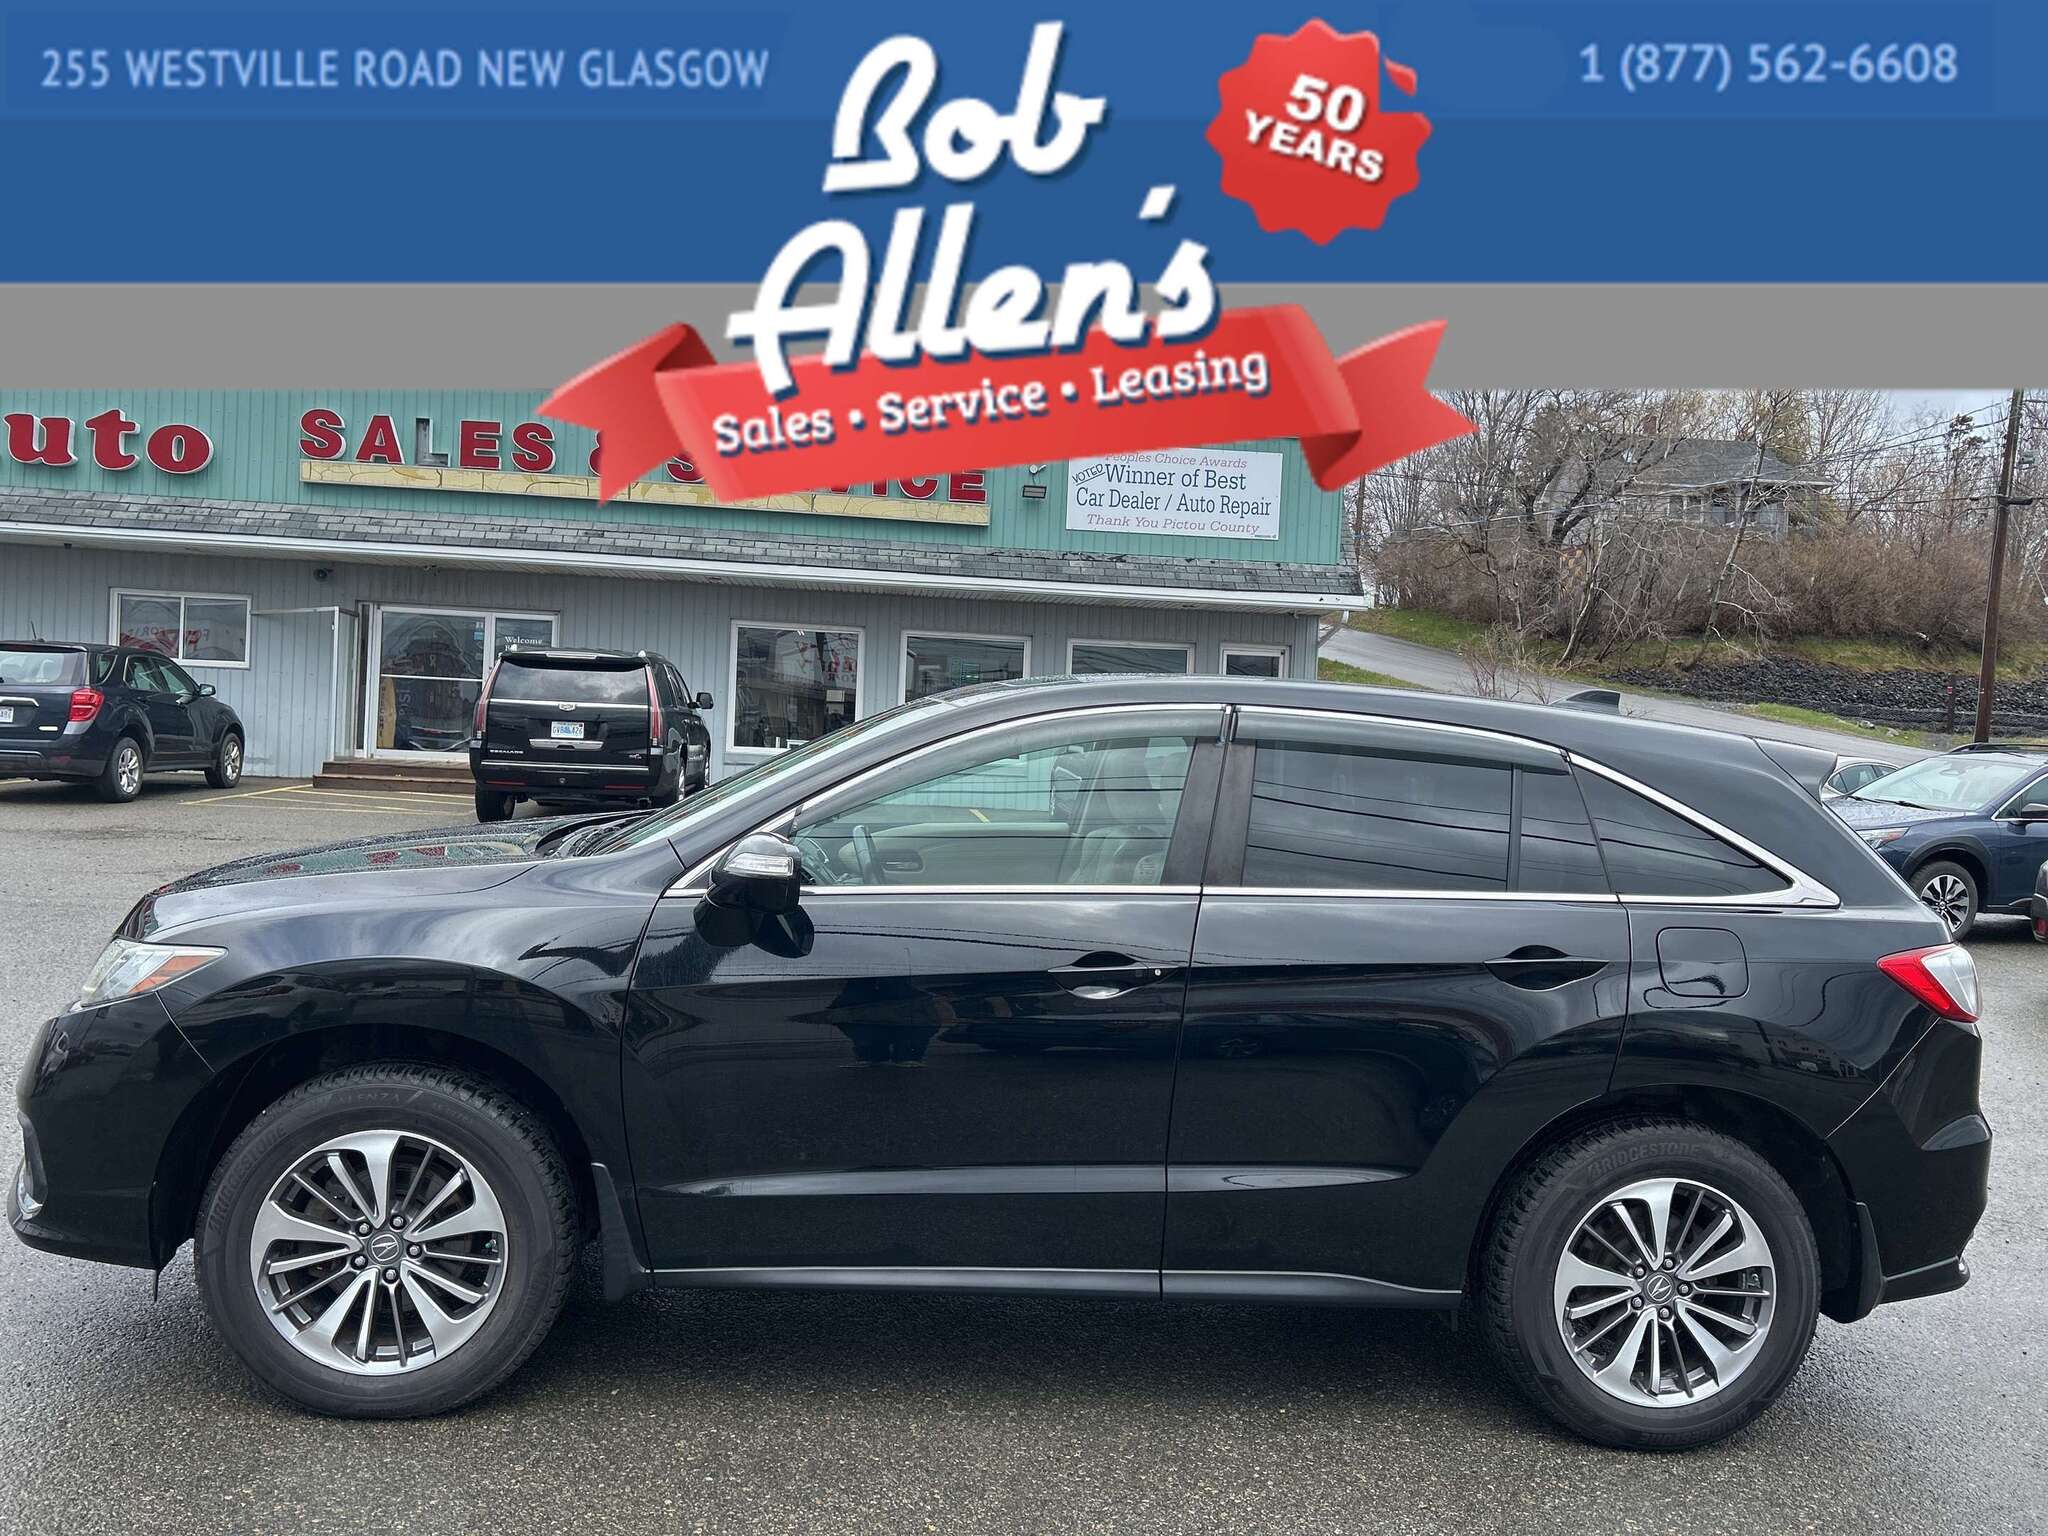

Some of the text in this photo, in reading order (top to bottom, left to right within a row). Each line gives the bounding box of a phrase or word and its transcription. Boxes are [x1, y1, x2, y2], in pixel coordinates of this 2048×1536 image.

[298, 407, 557, 474] SALES
[1155, 452, 1197, 465] Choice
[1200, 456, 1248, 469] Awards
[1072, 463, 1104, 485] VOTED
[1105, 463, 1247, 490] Winner of Best
[1076, 486, 1272, 519] Car Dealer / Auto Repair
[1087, 513, 1260, 536] Thank You Pictou County
[505, 636, 543, 645] Welcome
